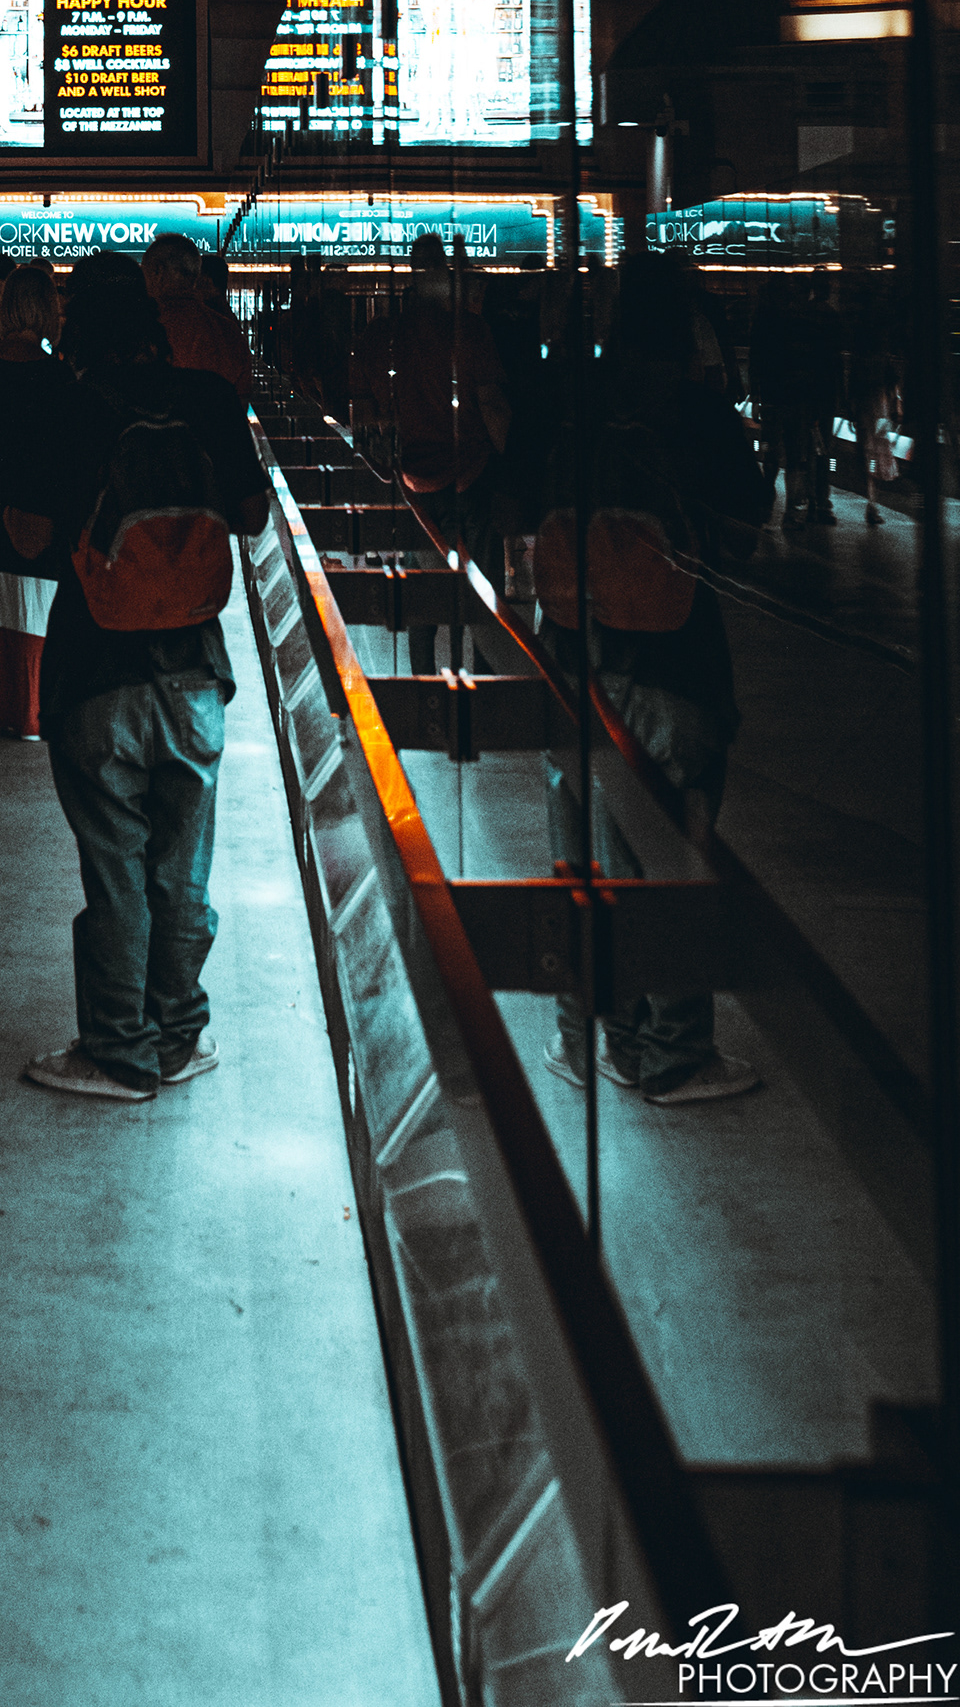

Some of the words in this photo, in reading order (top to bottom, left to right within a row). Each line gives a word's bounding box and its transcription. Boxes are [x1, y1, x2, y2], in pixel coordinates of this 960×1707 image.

[71, 11, 81, 23] 7
[116, 11, 126, 23] 9
[60, 24, 113, 36] MONDAY
[122, 24, 163, 36] FRIDAY
[61, 44, 79, 58] $6
[81, 44, 122, 57] DRAFT
[124, 44, 163, 57] BEERS
[71, 58, 105, 71] WELL
[105, 58, 171, 70] COCKTAILS
[65, 72, 89, 84] $10
[91, 72, 129, 84] DRAFT
[131, 72, 159, 84] BEER
[57, 86, 86, 97] AND
[87, 86, 98, 97] A
[100, 86, 132, 97] WELL
[133, 85, 167, 97] SHOT
[59, 107, 105, 119] LOCATED
[106, 107, 120, 118] AT
[121, 107, 141, 118] THE
[142, 106, 165, 118] TOP
[62, 121, 78, 132] OF
[78, 121, 99, 132] THE
[99, 120, 162, 132] MEZZANINE
[21, 210, 62, 220] WELCOME
[62, 210, 75, 219] TO
[1, 245, 38, 257] HOTEL
[40, 245, 51, 257] &
[53, 245, 102, 257] CASINO
